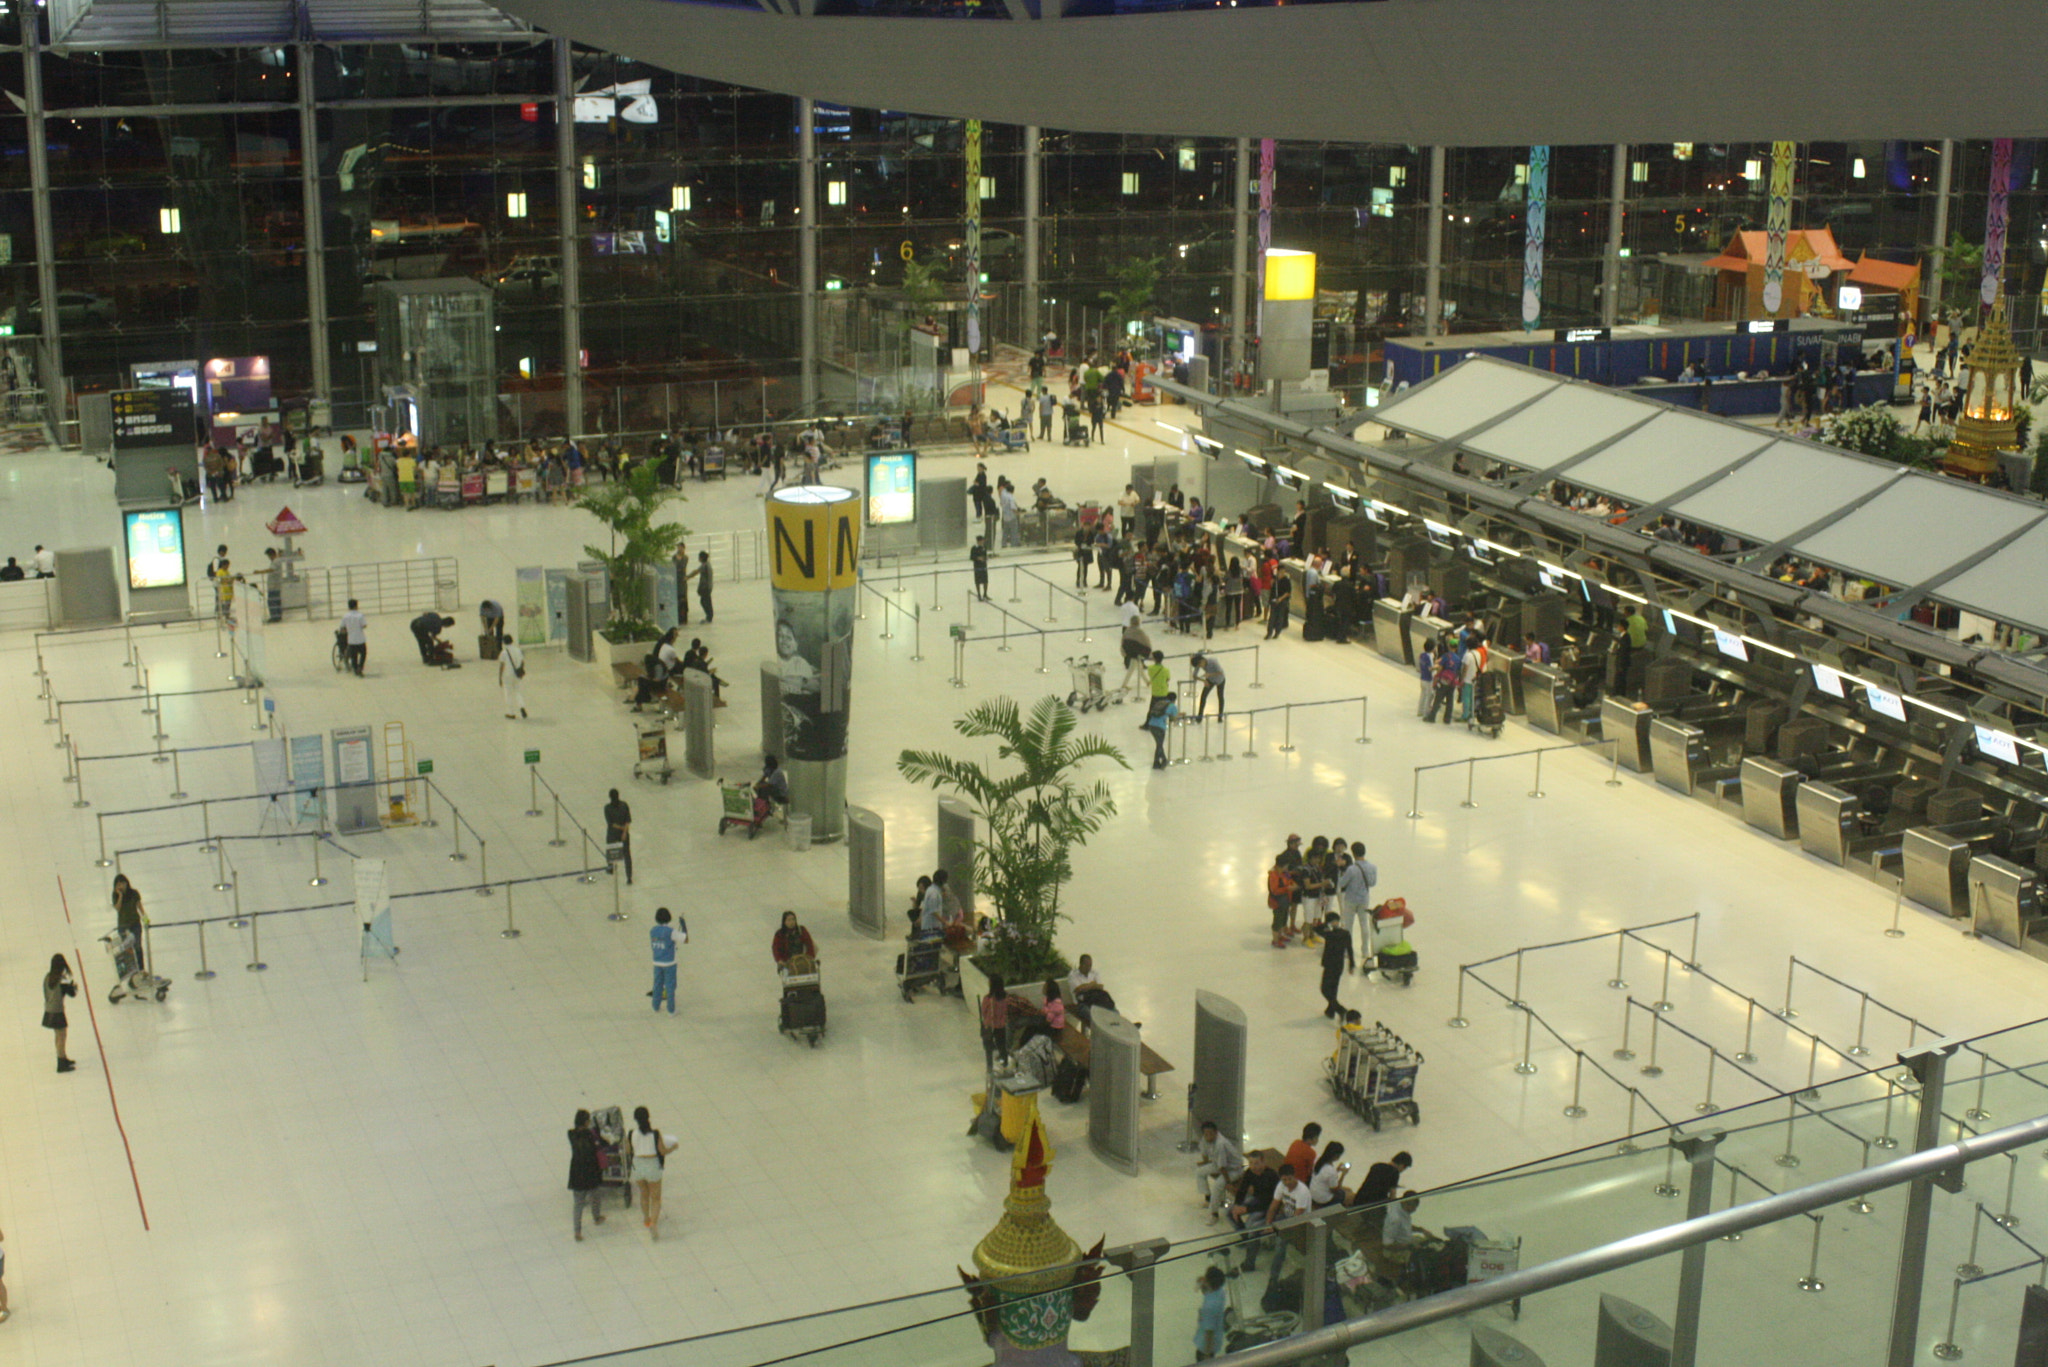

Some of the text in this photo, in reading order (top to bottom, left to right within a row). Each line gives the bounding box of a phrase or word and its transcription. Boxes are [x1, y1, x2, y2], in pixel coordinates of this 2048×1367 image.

[1675, 214, 1686, 233] 5
[901, 240, 913, 260] 6
[774, 516, 815, 578] N
